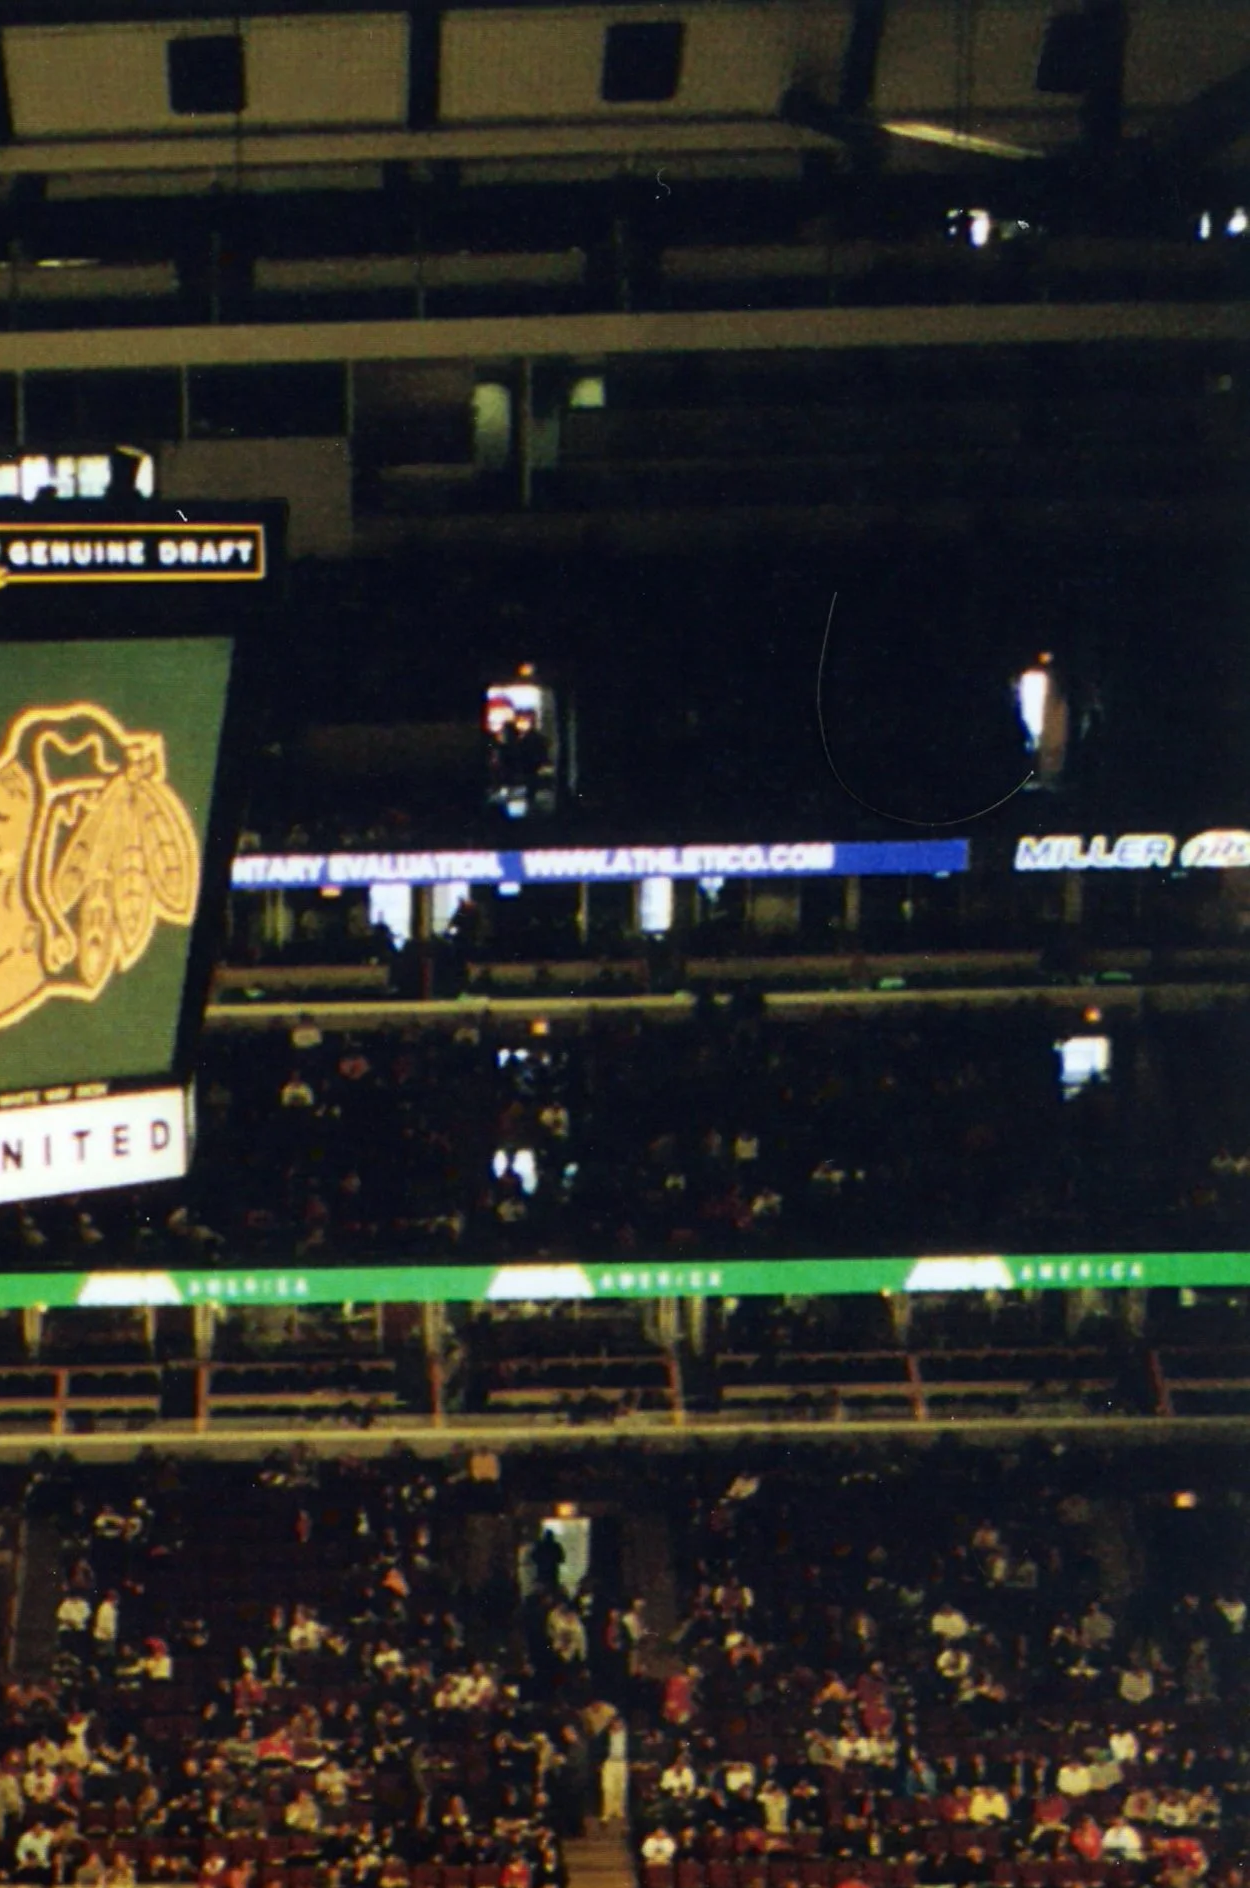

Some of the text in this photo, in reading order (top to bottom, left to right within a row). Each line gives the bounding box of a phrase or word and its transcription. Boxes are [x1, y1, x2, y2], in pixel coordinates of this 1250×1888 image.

[8, 540, 145, 566] GENUINE
[158, 540, 253, 565] DRAFT
[1013, 833, 1176, 870] MILLER
